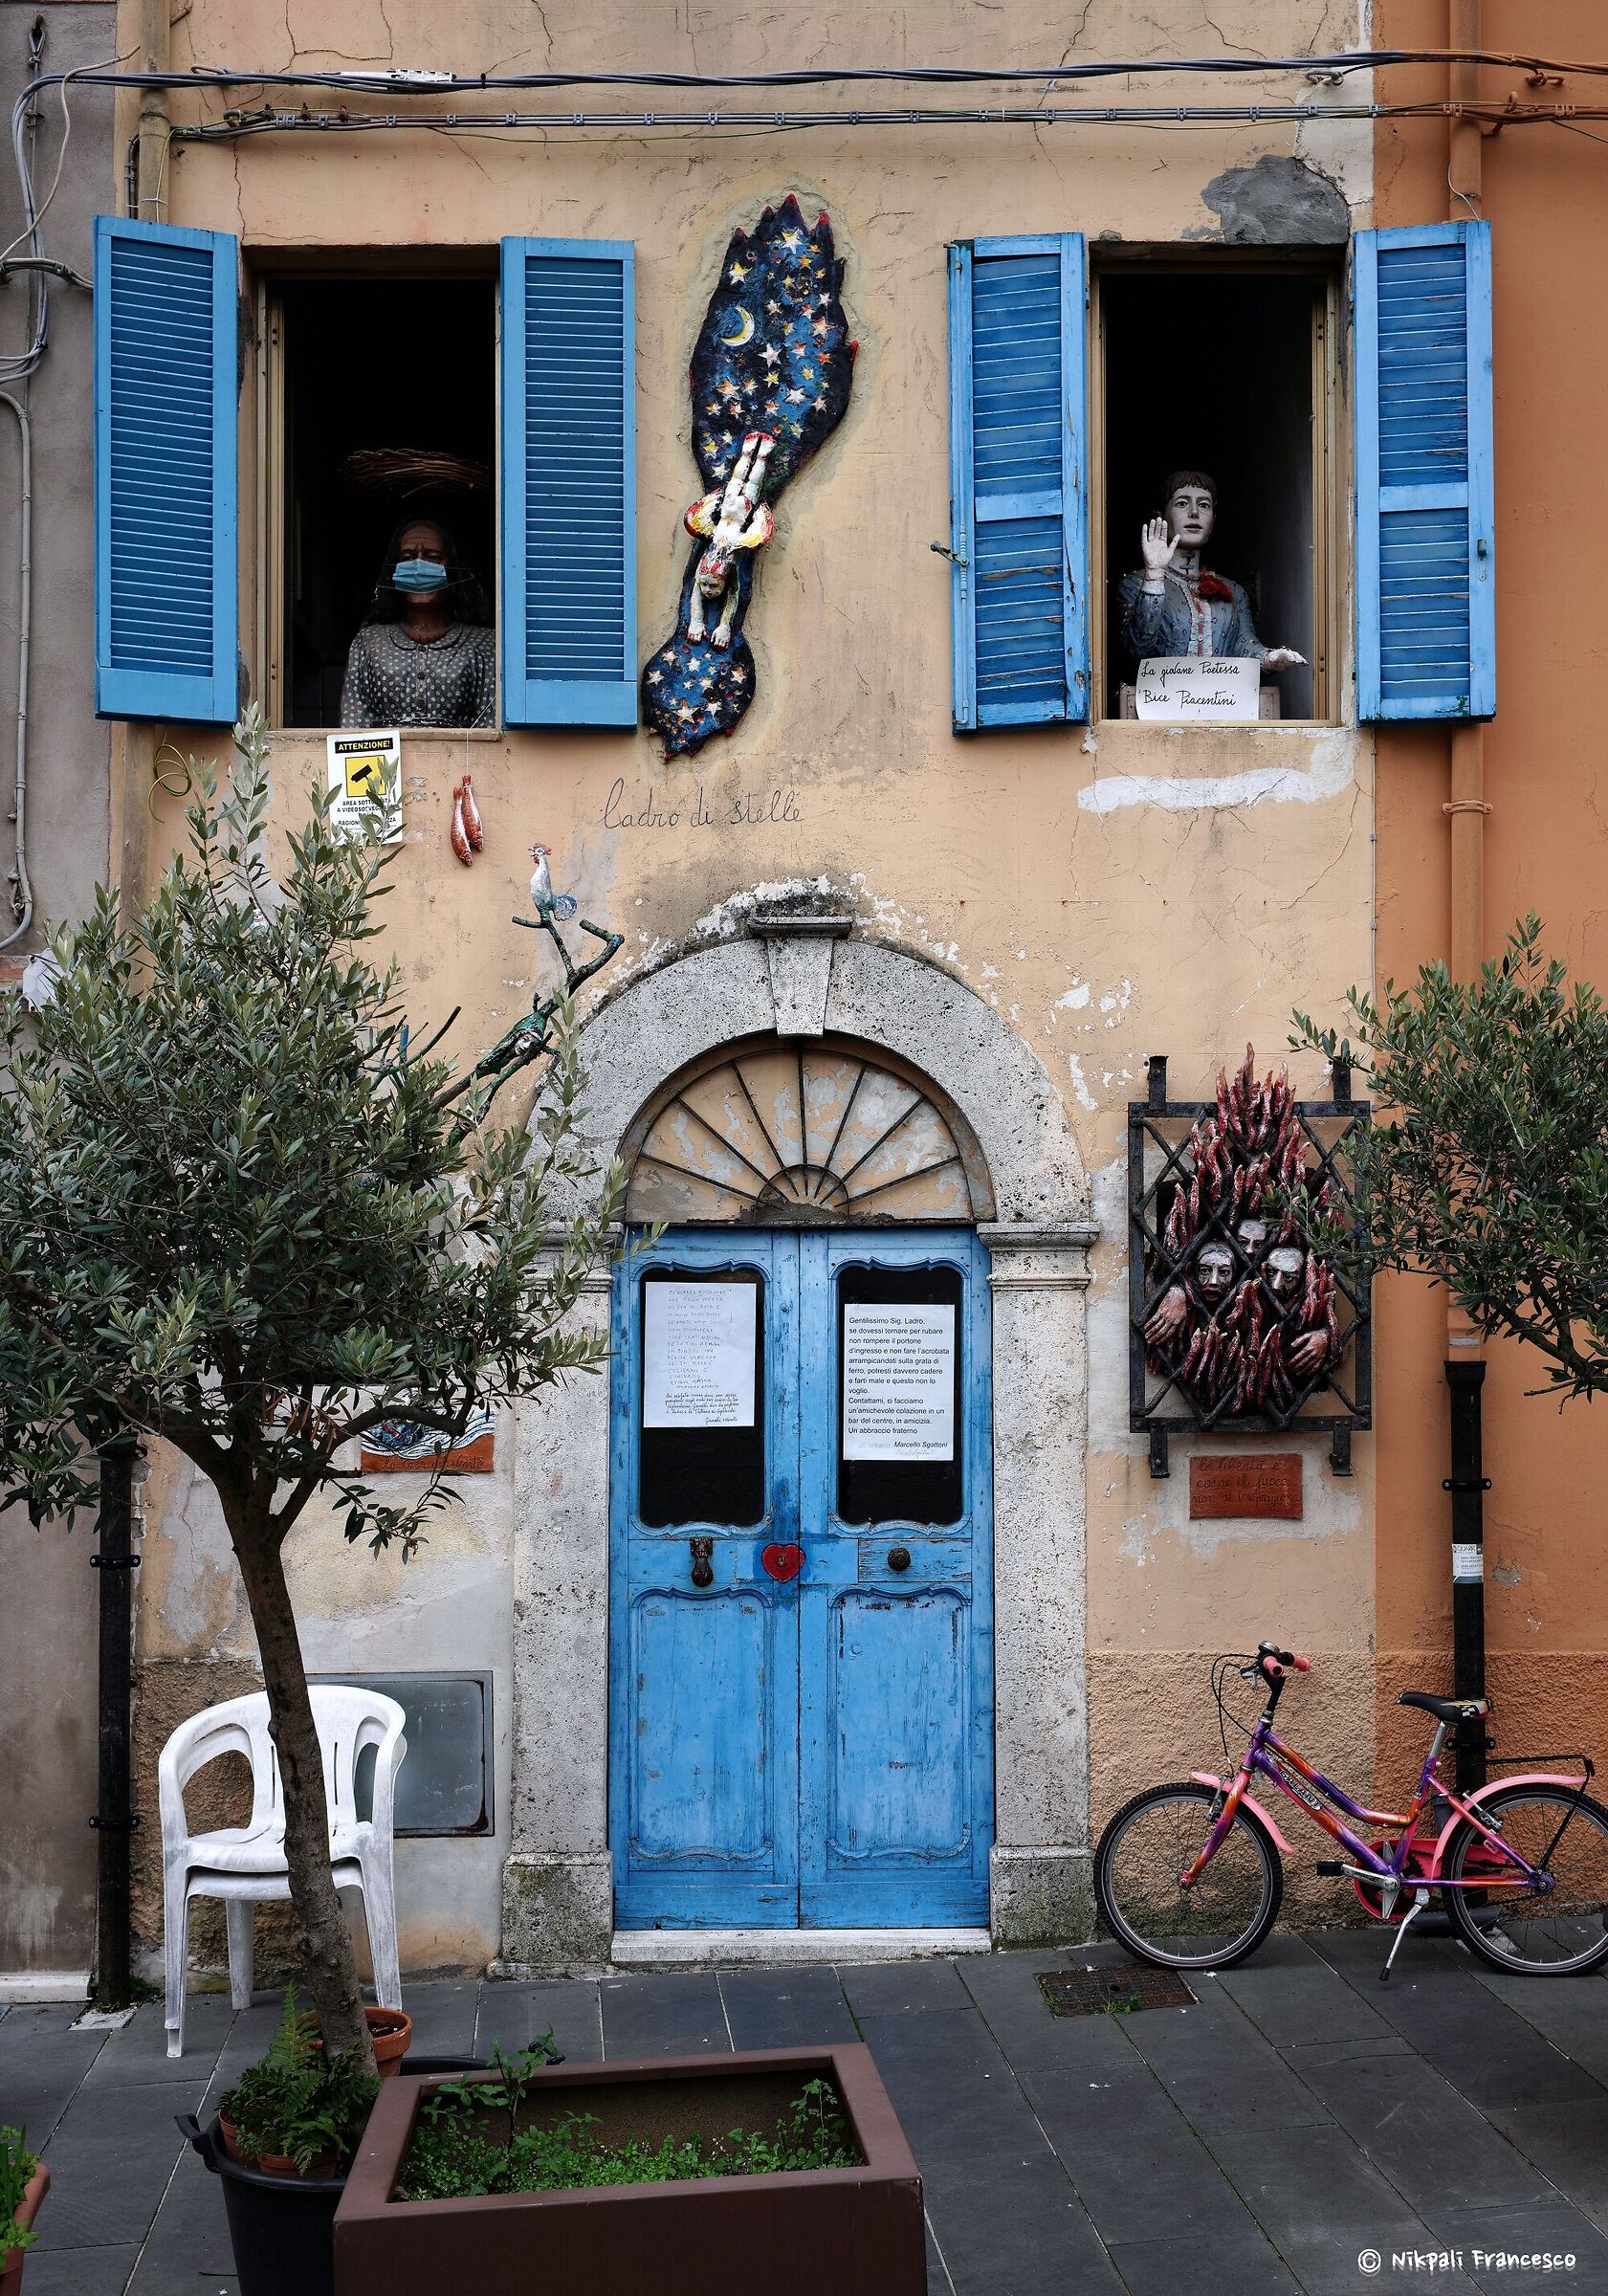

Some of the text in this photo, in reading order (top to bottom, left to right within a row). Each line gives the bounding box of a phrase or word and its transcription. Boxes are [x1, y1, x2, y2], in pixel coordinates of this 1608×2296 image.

[1140, 661, 1156, 677] La
[1199, 661, 1241, 675] Poetessa
[1143, 689, 1237, 710] Bice Piacentini
[339, 740, 390, 751] ATTENZIONE!
[690, 786, 716, 828] di
[724, 789, 806, 826] stelle
